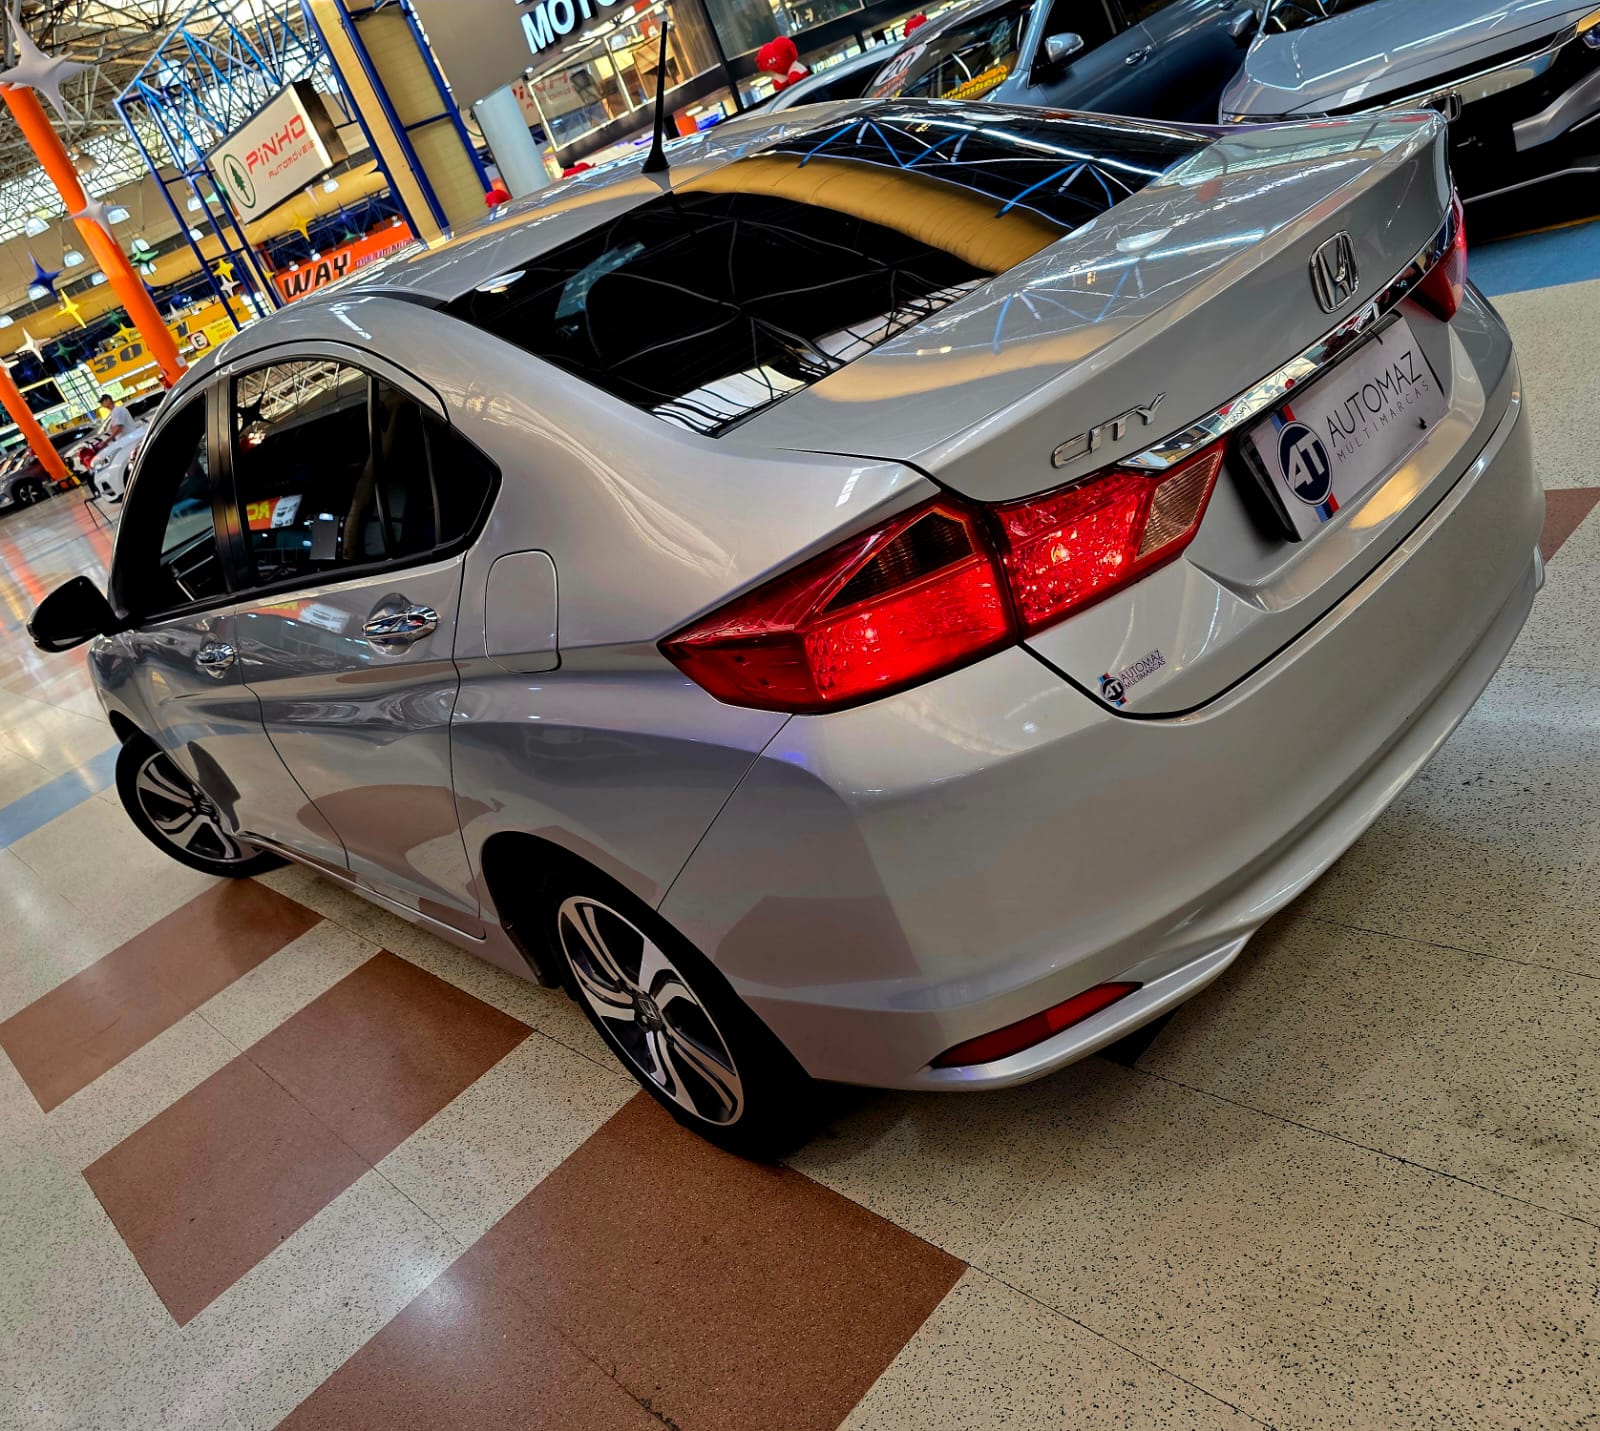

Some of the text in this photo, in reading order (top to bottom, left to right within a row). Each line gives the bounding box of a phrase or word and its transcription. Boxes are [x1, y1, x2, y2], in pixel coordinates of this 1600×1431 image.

[283, 250, 350, 299] WAY
[1050, 392, 1166, 469] CITY
[1326, 350, 1422, 448] AUTOMAZ
[1336, 380, 1430, 463] MULTIMARCAS
[1120, 648, 1162, 682] AUTOMAZ
[1124, 656, 1166, 690] MULTIMARCAS
